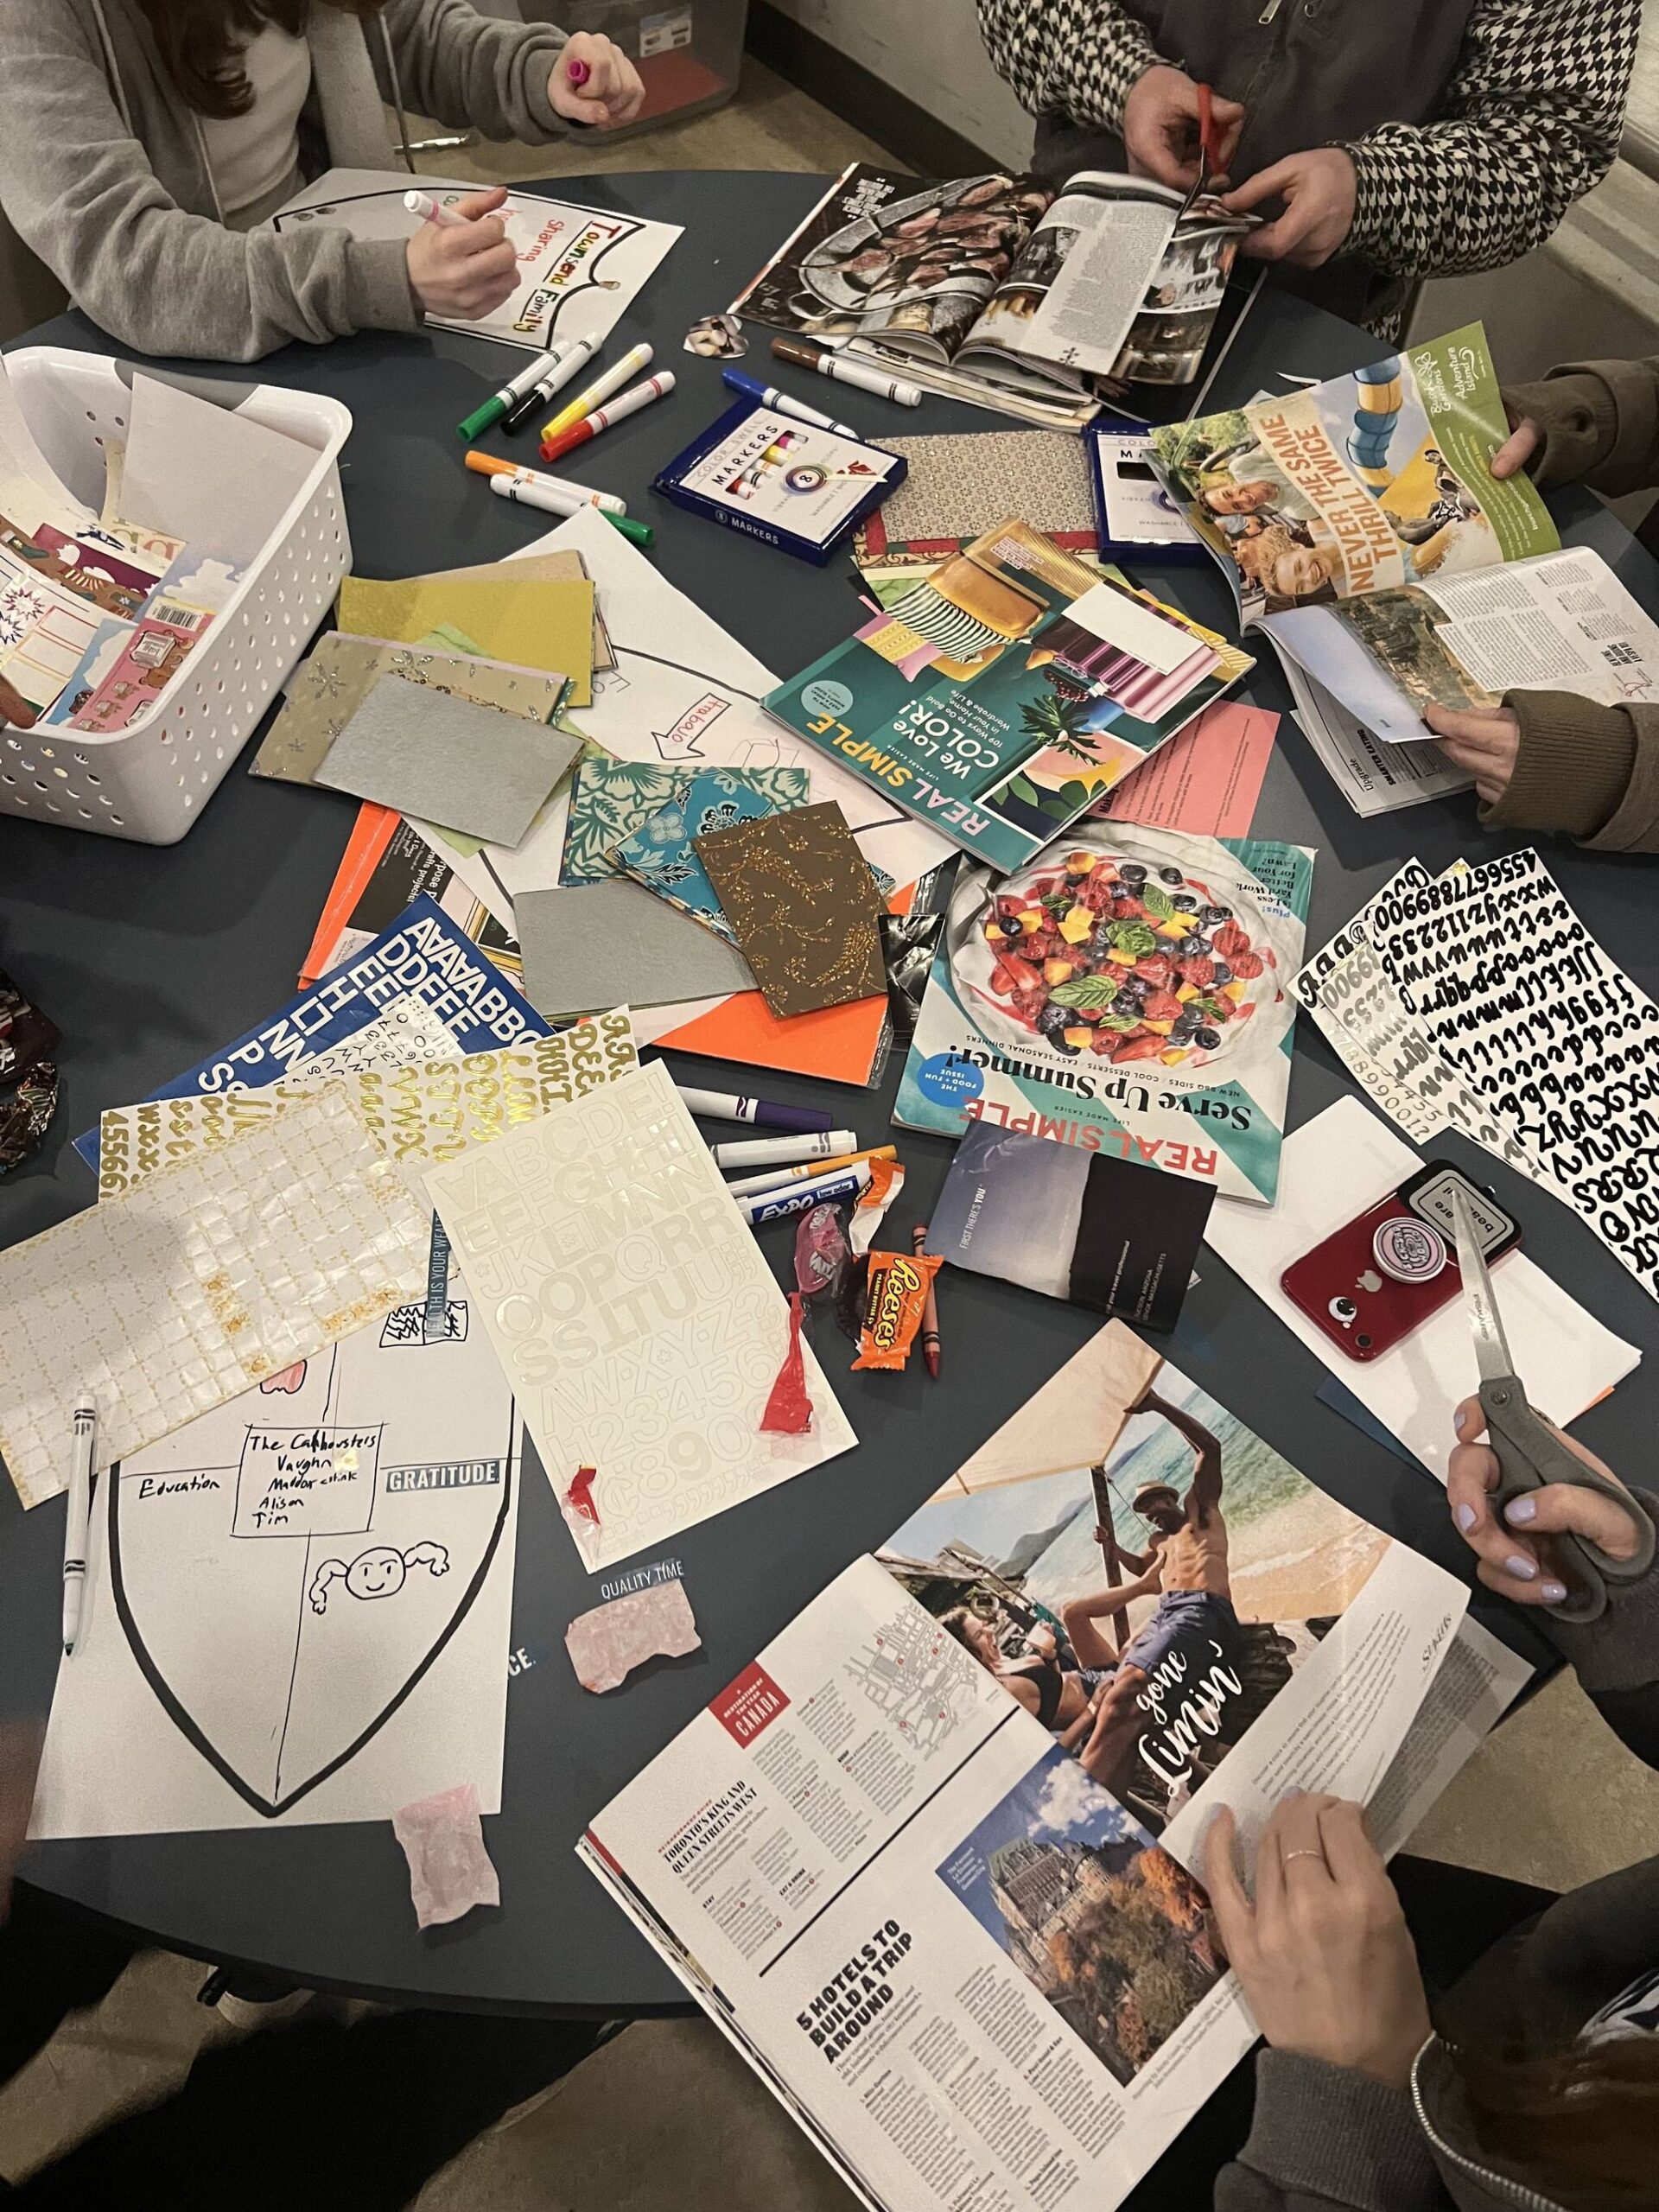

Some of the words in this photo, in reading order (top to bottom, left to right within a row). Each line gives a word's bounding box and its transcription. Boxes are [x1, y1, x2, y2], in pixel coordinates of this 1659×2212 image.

[516, 219, 565, 263] sharing
[550, 222, 622, 287] Townsend
[513, 289, 560, 334] Family
[1448, 346, 1467, 397] Adventure
[1460, 362, 1475, 389] Island
[712, 425, 779, 486] MARKERS
[1258, 412, 1312, 474] SAME
[1294, 423, 1351, 486] TWICE
[1296, 471, 1338, 509] THE
[731, 517, 779, 544] MARKERS
[1341, 487, 1397, 564] THRILL
[1324, 507, 1375, 591] NEVER
[925, 695, 945, 709] Bold
[948, 689, 967, 701] Life
[944, 707, 959, 717] Go
[969, 714, 991, 728] Your
[971, 703, 1012, 730] Wardrobe
[887, 720, 941, 756] Love
[895, 700, 1003, 769] COLOR!
[965, 721, 991, 738] Ways
[987, 735, 1004, 747] 109
[1355, 728, 1376, 753] EATING
[803, 712, 917, 786] SIMPLE
[935, 752, 973, 777] We
[1347, 757, 1376, 791] Upgrade
[1371, 754, 1396, 785] SMARTER
[906, 779, 991, 835] REAL
[429, 861, 447, 889] rpose
[1251, 866, 1276, 875] Your
[1262, 857, 1296, 869] Lawn?
[1278, 869, 1295, 879] for
[1235, 882, 1265, 893] Work
[1259, 876, 1294, 888] Better
[1268, 887, 1292, 899] Yard
[1255, 895, 1280, 906] Less
[1262, 906, 1290, 918] Plus!
[963, 1033, 1004, 1049] DINNERS
[1005, 1042, 1053, 1060] SEASONAL
[944, 1043, 1097, 1101] Summer!
[1053, 1053, 1078, 1065] EASY
[1085, 1060, 1130, 1077] DESSERTS
[925, 1072, 943, 1081] FUN
[939, 1069, 964, 1078] ISSUE
[951, 1078, 976, 1088] FOOD
[1132, 1070, 1160, 1083] COOL
[1167, 1077, 1194, 1090] SIDES
[940, 1083, 957, 1091] THE
[1100, 1072, 1154, 1114] Up
[1195, 1082, 1217, 1094] BBQ
[1217, 1086, 1240, 1098] NEW
[957, 1093, 1105, 1152] SIMPLE
[1052, 1103, 1083, 1116] EASIER
[1084, 1110, 1109, 1122] MADE
[1110, 1116, 1130, 1127] LIFE
[1154, 1086, 1253, 1135] Serve
[1103, 1125, 1220, 1178] REAL
[761, 1194, 813, 1221] EXPO
[818, 1188, 833, 1198] low
[831, 1182, 851, 1193] odor
[1433, 1199, 1455, 1220] are
[964, 1203, 981, 1230] THERE'S
[958, 1229, 972, 1249] FIRST
[430, 1250, 446, 1278] YOUR
[1110, 1274, 1120, 1291] travel
[1116, 1239, 1130, 1275] professional
[1147, 1251, 1166, 1301] MASSACHUSETTS
[429, 1281, 444, 1293] IS
[872, 1272, 883, 1295] PEANUT
[868, 1294, 879, 1316] BUTTER
[874, 1258, 921, 1351] Reese's
[250, 1435, 284, 1452] The
[277, 1454, 332, 1477] Vaughn
[139, 1473, 220, 1499] Education
[268, 1476, 318, 1493] Maddox
[258, 1497, 305, 1510] Alison
[252, 1512, 289, 1529] Tim
[600, 1569, 652, 1600] QUALITY
[653, 1559, 684, 1584] TIME
[1133, 1650, 1183, 1724] gone
[734, 1689, 779, 1737] CANADA
[735, 1703, 747, 1715] THE
[745, 1689, 760, 1706] YEAR
[1136, 1639, 1242, 1797] Limin'
[662, 1815, 709, 1863] TORONTO'S
[706, 1795, 730, 1821] KING
[727, 1779, 747, 1801] AND
[671, 1840, 702, 1875] QUEEN
[697, 1808, 736, 1848] STREETS
[732, 1785, 759, 1814] WEST
[796, 2010, 813, 2031] 5
[808, 1942, 878, 2018] HOTELS
[873, 1916, 901, 1949] TO
[808, 1986, 863, 2048] BUILD
[857, 1972, 875, 1994] A
[871, 1929, 915, 1980] TRIP
[820, 1980, 895, 2063] AROUND
